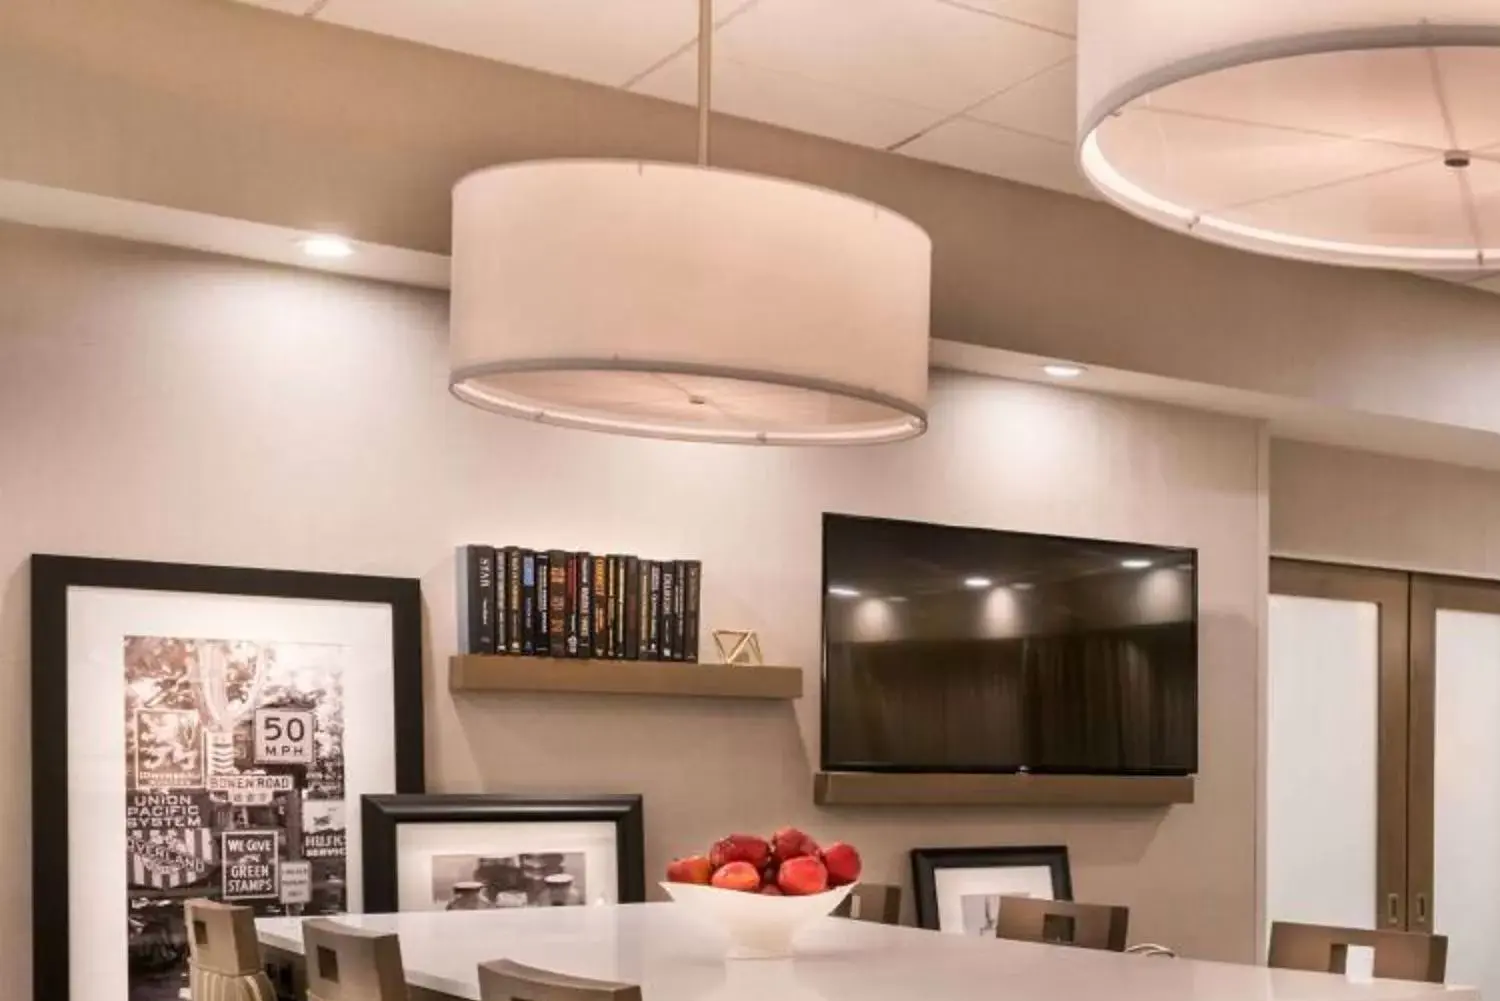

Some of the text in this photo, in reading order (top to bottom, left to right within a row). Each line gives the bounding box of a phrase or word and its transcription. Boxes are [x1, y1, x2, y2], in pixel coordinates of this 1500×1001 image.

[264, 717, 305, 742] 50
[265, 745, 303, 756] MPH
[257, 777, 289, 788] ROAD
[134, 795, 191, 806] UNION
[127, 805, 199, 817] PACIFIC
[127, 816, 201, 827] SYSTEM
[228, 839, 271, 852] WE GIVE
[231, 865, 269, 878] GREEN
[228, 878, 272, 891] STAMPS
